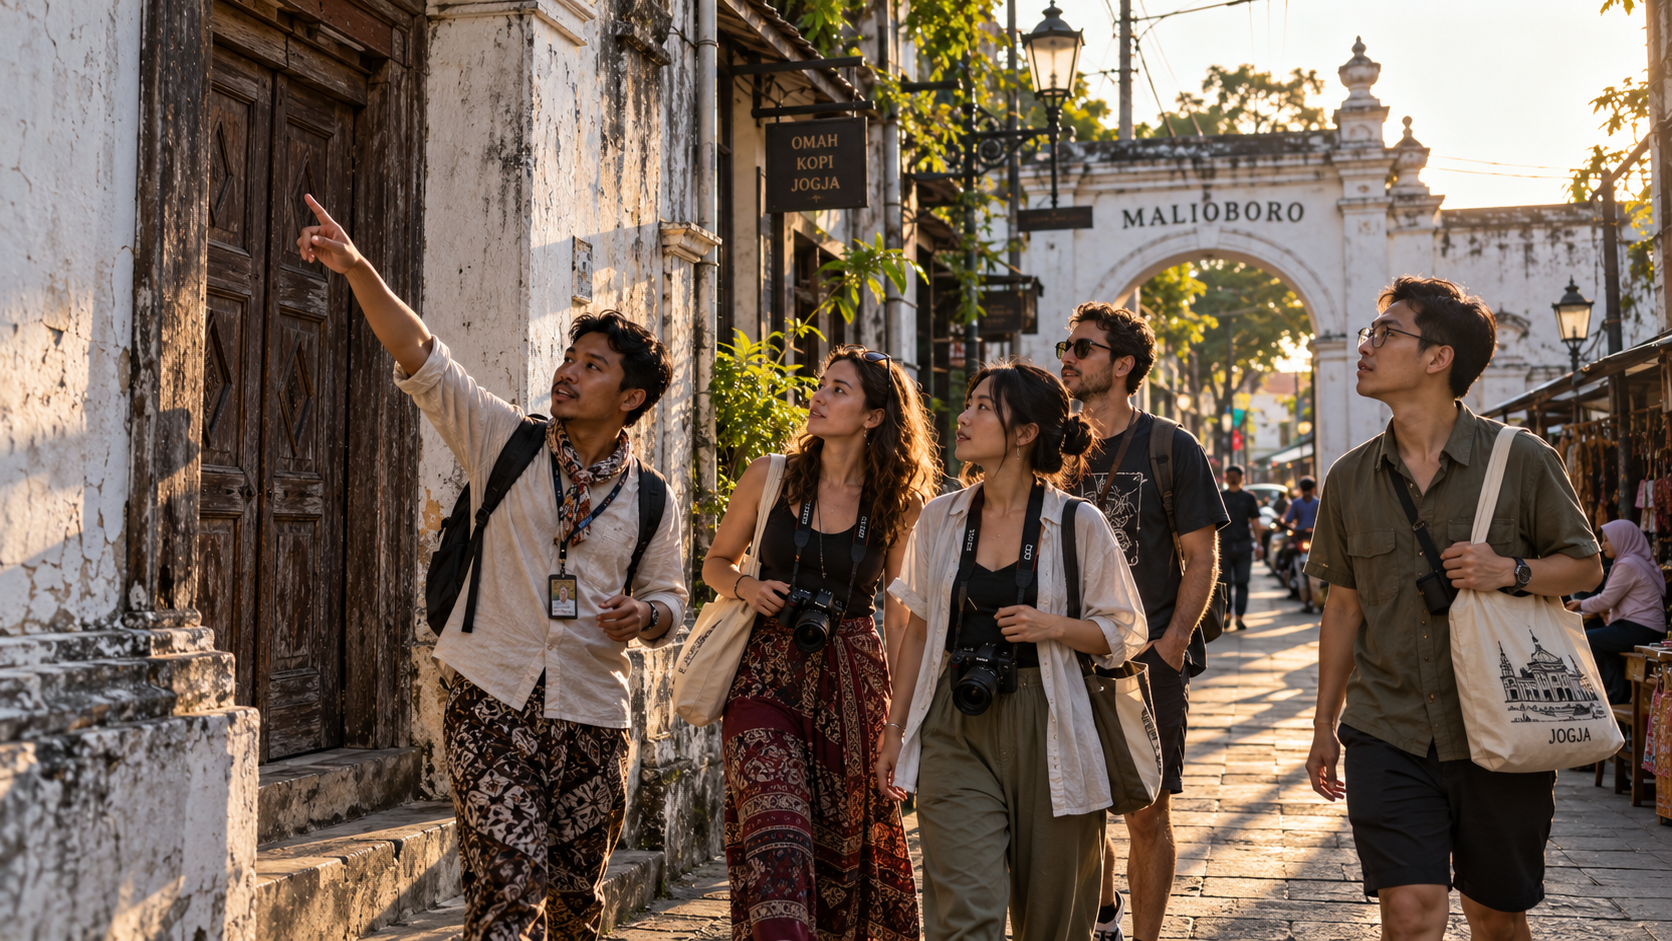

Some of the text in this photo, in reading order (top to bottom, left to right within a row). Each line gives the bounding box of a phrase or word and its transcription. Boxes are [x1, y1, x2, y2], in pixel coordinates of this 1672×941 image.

[791, 133, 839, 150] OMAH
[796, 155, 834, 170] KOPI
[791, 176, 841, 192] JOGJA
[1122, 201, 1304, 229] MALIOBORO
[1548, 727, 1592, 745] JOGJA
